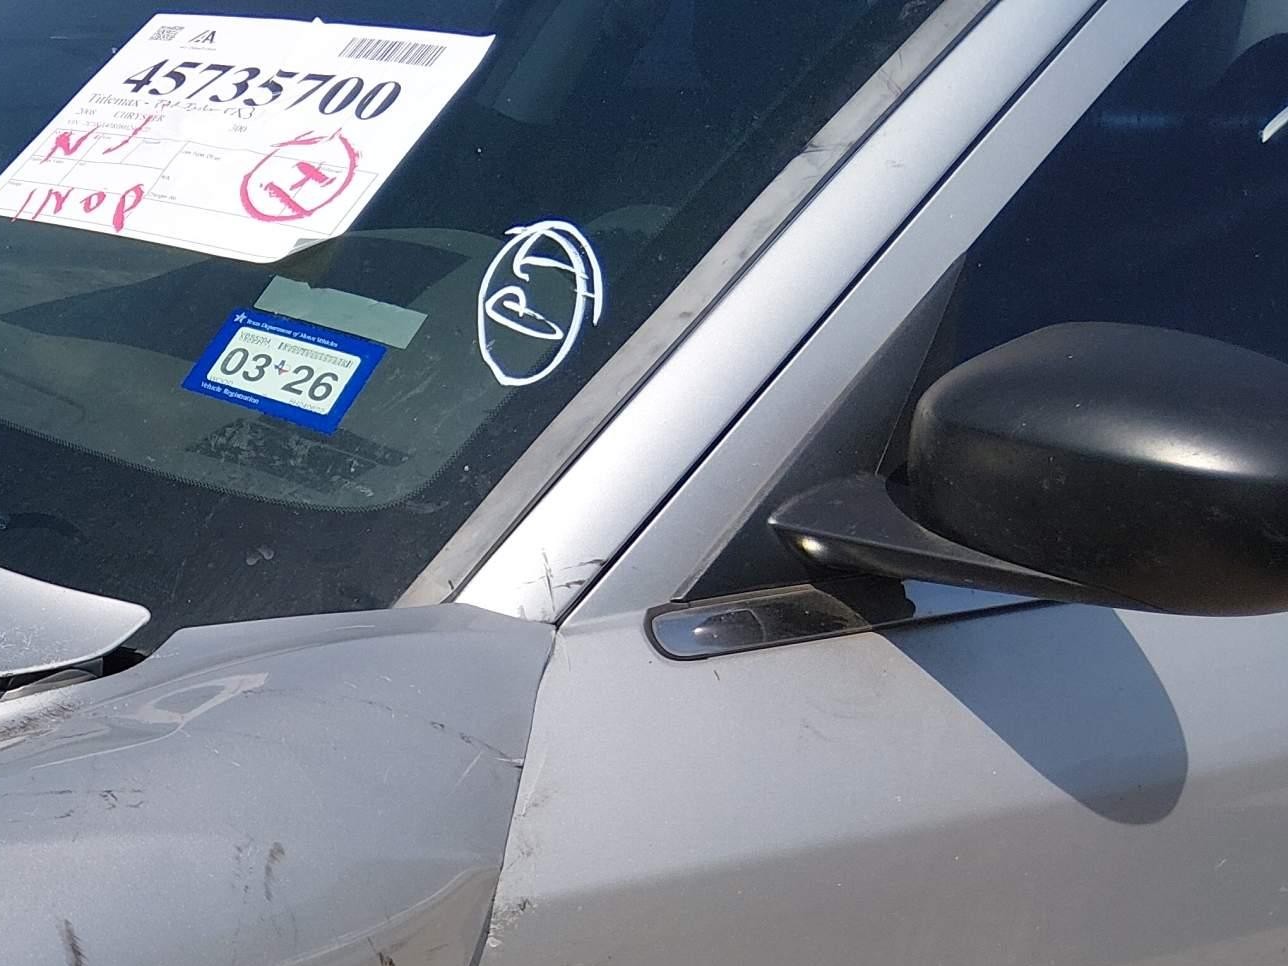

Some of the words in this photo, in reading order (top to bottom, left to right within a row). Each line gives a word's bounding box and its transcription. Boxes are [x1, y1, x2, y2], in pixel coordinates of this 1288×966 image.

[113, 111, 166, 122] CHRYSER
[123, 58, 402, 121] 45735700
[220, 347, 273, 382] 03
[281, 365, 340, 402] 26
